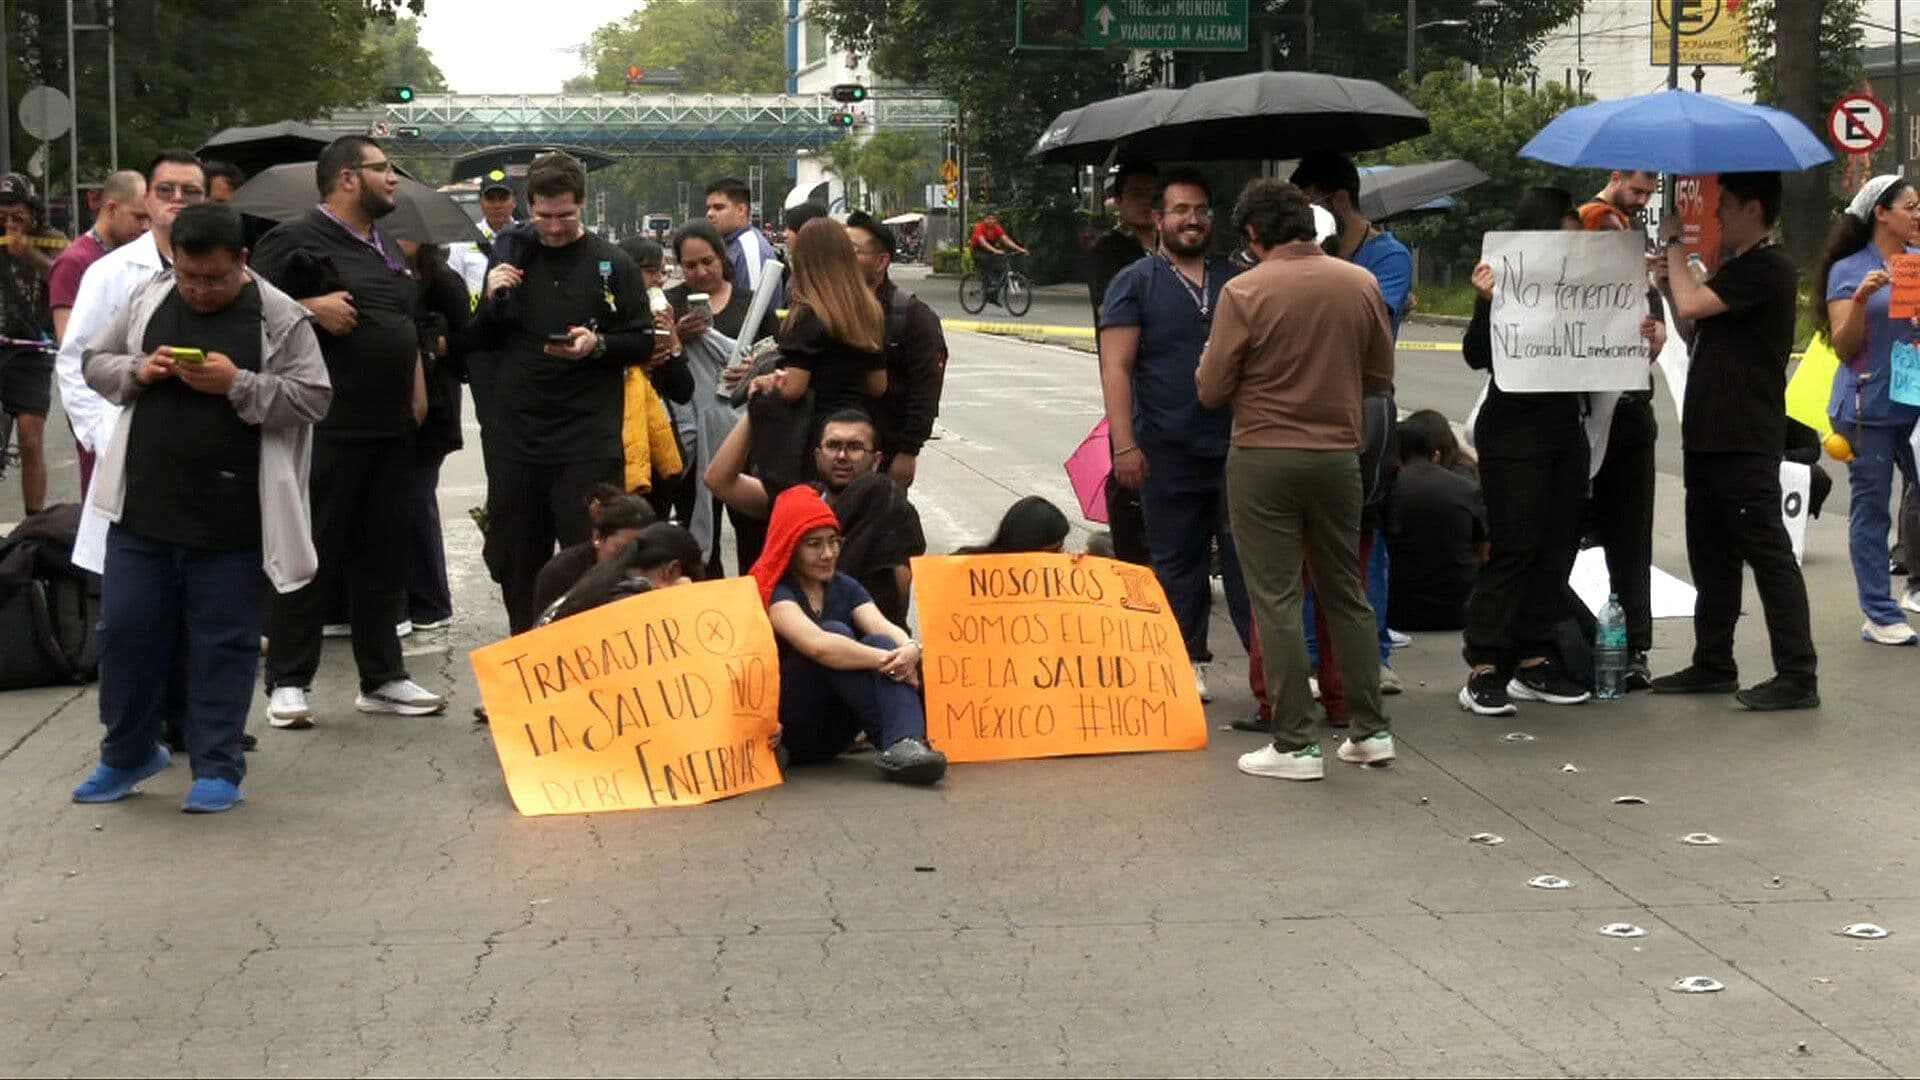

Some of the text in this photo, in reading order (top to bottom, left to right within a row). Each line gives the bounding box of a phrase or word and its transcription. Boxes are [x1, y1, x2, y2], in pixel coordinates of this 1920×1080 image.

[1174, 0, 1230, 16] MUNDIAL
[1120, 23, 1242, 41] VIADUCTO M ALEMAN
[1501, 251, 1635, 311] No tenemos
[1493, 321, 1522, 359] NI
[1564, 321, 1587, 358] NI
[969, 566, 1105, 601] NOSOTROS
[949, 612, 1173, 658] SOMOS EL PILAR
[501, 616, 691, 704] TRABAJAR
[938, 655, 1178, 699] DE LA SALUD EN
[524, 656, 767, 757] LA SALUD NO
[946, 694, 1169, 742] MÉXICO #HGM
